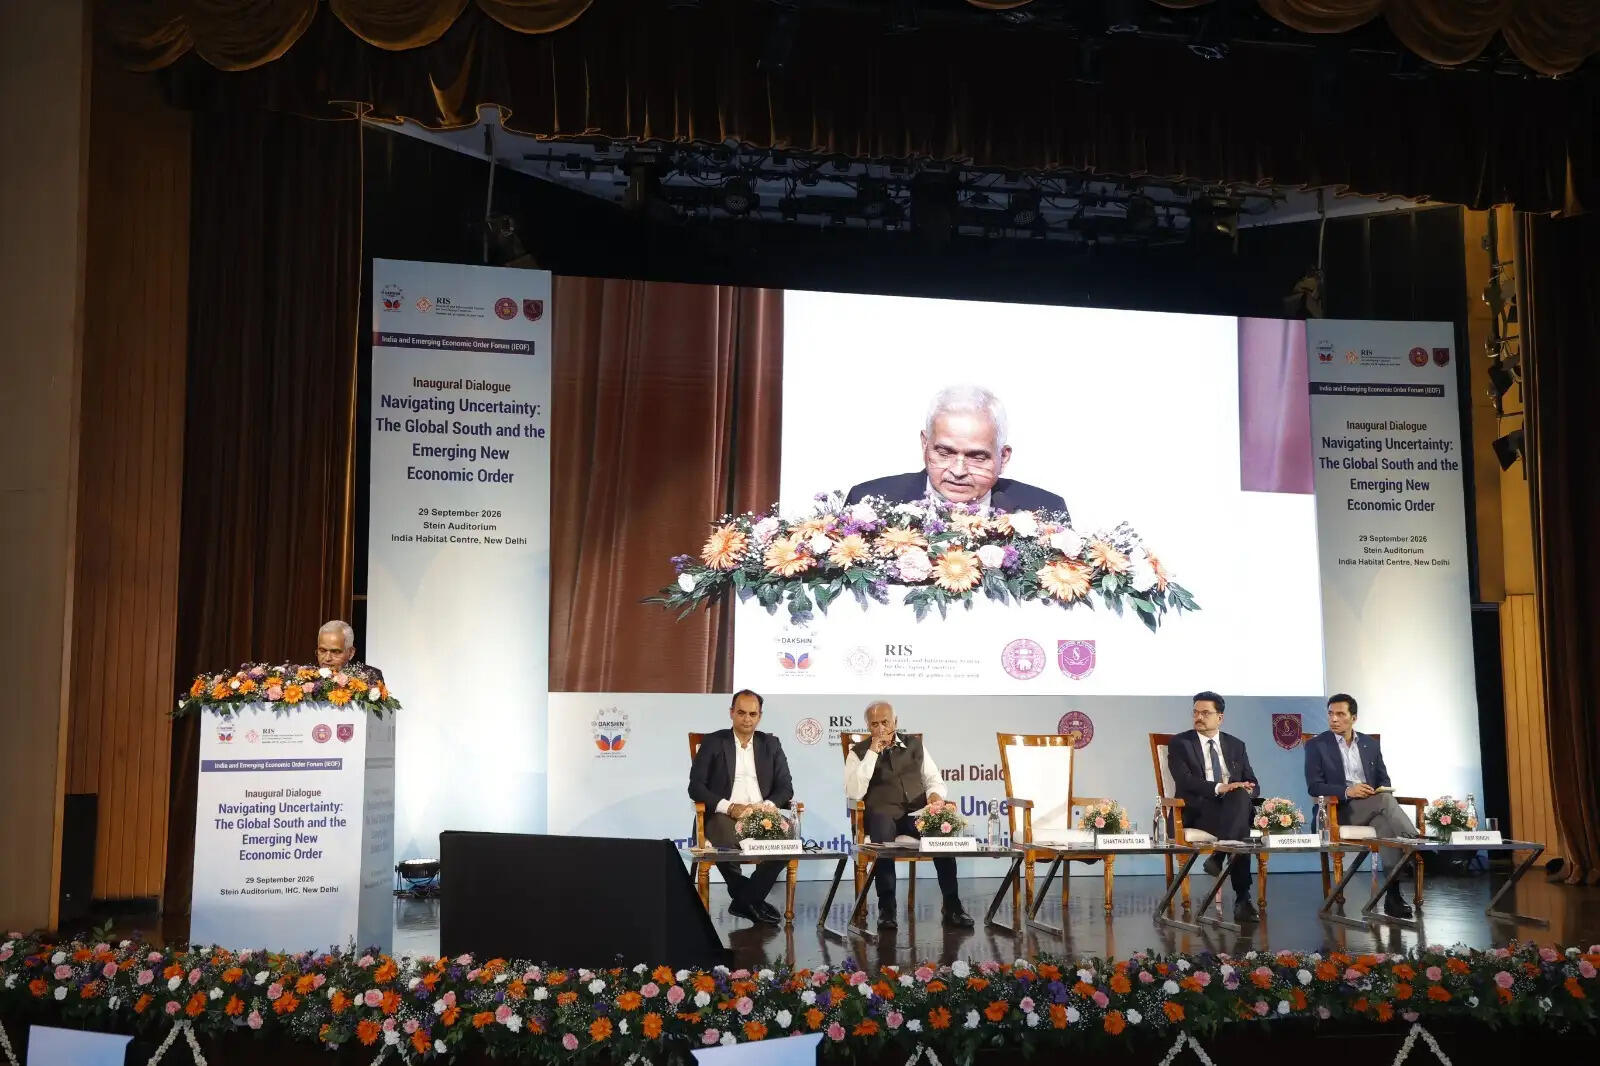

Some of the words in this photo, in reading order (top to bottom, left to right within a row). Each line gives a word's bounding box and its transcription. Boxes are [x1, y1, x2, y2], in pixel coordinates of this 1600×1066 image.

[382, 335, 398, 343] India
[412, 337, 441, 347] Emerging
[442, 340, 472, 348] Economic
[473, 341, 489, 349] Order
[490, 342, 510, 350] Forum
[413, 377, 462, 391] Inaugural
[465, 379, 511, 394] Dialogue
[380, 394, 455, 415] Navigating
[459, 399, 541, 418] Uncertainty:
[376, 418, 401, 432] The
[405, 420, 449, 434] Global
[452, 421, 492, 436] South
[496, 424, 520, 438] and
[524, 425, 546, 439] the
[1346, 420, 1387, 432] Inaugural
[1389, 421, 1428, 433] Dialogue
[1322, 436, 1383, 452] Navigating
[1385, 438, 1453, 453] Uncertainty:
[412, 443, 477, 462] Emerging
[480, 446, 510, 460] New
[1319, 457, 1340, 470] The
[1343, 457, 1378, 470] Global
[1381, 458, 1414, 471] South
[1417, 459, 1438, 471] and
[1441, 459, 1459, 471] the
[407, 466, 474, 482] Economic
[477, 469, 514, 484] Order
[1350, 478, 1403, 494] Emerging
[1406, 479, 1430, 491] New
[1347, 499, 1402, 512] Economic
[1404, 499, 1436, 512] Order
[418, 508, 429, 516] 29
[431, 508, 479, 519] September
[481, 510, 502, 518] 2026
[423, 522, 446, 530] Stein
[448, 523, 497, 531] Auditorium
[391, 534, 413, 542] India
[415, 535, 447, 543] Habitat
[449, 535, 482, 545] Centre,
[484, 536, 503, 545] New
[505, 536, 527, 545] Delhi
[1369, 535, 1409, 544] September
[1358, 558, 1384, 566] Habitat
[884, 644, 913, 656] RIS
[829, 715, 852, 727] RIS
[240, 762, 265, 770] Emerging
[245, 789, 284, 800] Inaugural
[285, 788, 322, 798] Dialogue
[218, 802, 276, 816] Navigating
[278, 801, 343, 813] Uncertainty:
[214, 818, 234, 830] The
[236, 818, 271, 829] Global
[273, 818, 305, 829] South
[307, 817, 328, 828] and
[329, 817, 347, 827] the
[242, 833, 292, 847] Emerging
[295, 833, 318, 844] New
[239, 849, 291, 860] Economic
[294, 848, 323, 860] Order
[256, 876, 295, 885] September
[241, 887, 284, 895] Auditorium,
